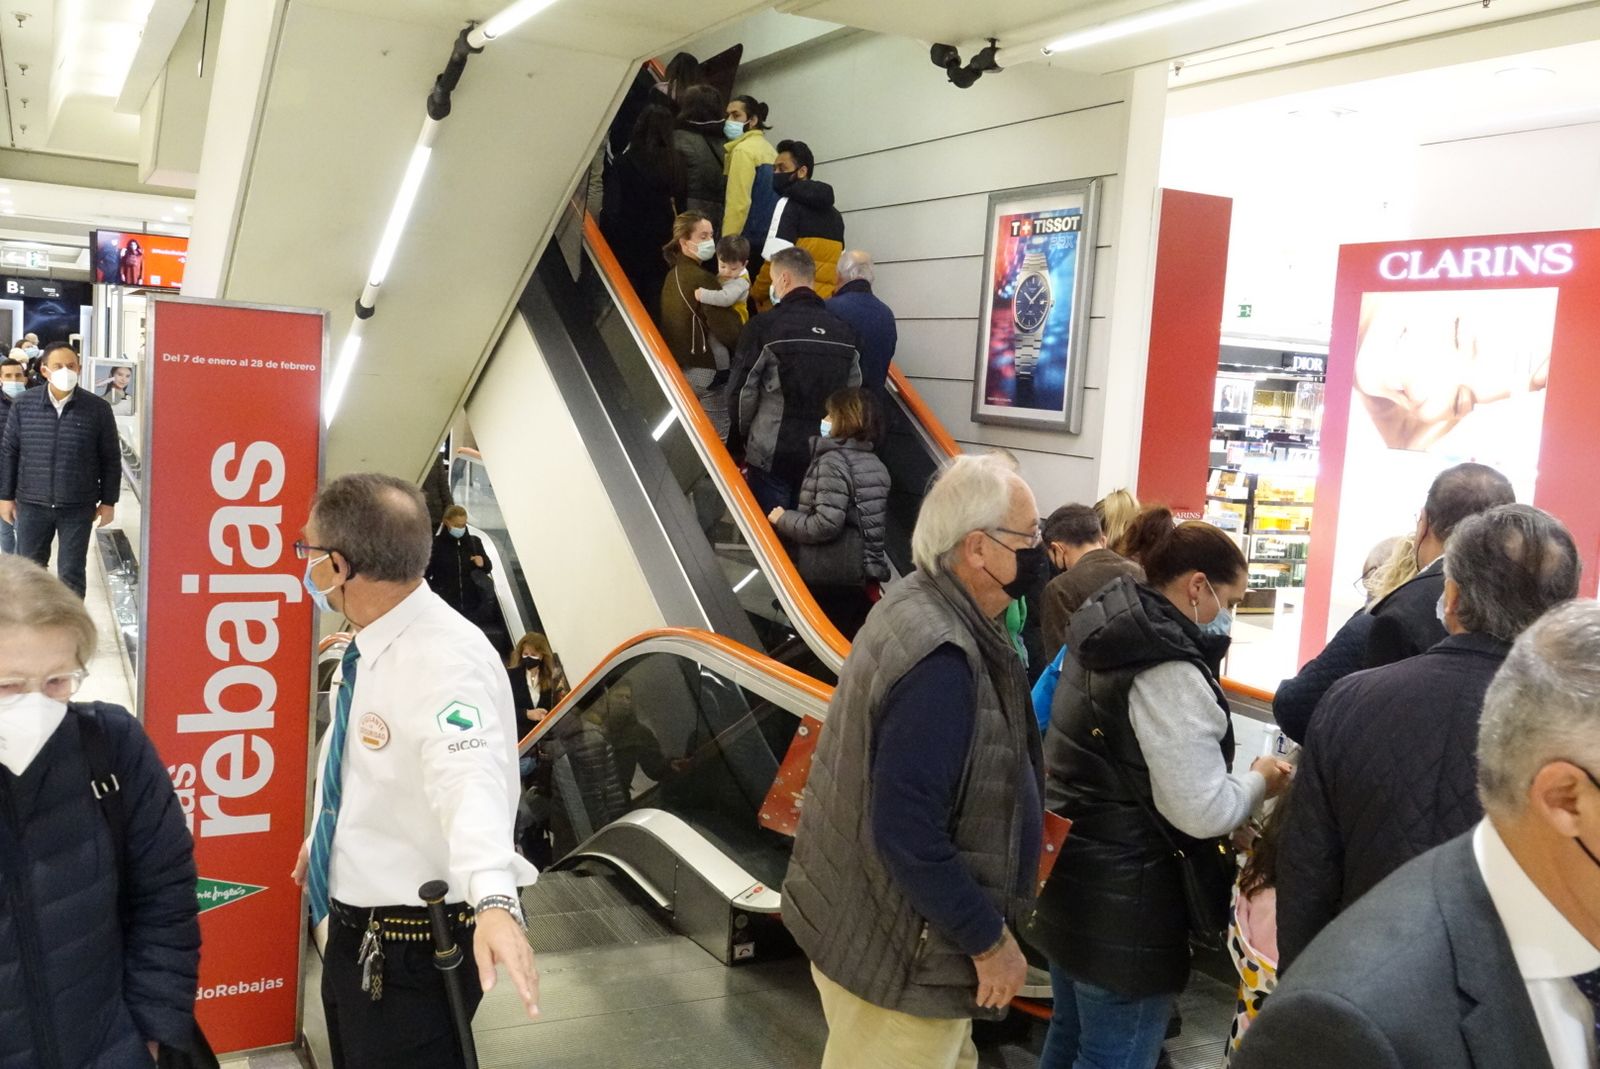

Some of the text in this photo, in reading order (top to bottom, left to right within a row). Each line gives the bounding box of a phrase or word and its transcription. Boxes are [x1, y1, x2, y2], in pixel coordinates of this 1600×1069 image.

[1034, 215, 1080, 234] TISSOT
[1378, 242, 1575, 280] CLARINS
[163, 353, 317, 371] Del 7 de enero al 28 de febrero
[1293, 355, 1324, 371] DIOR
[177, 440, 302, 838] rebajas
